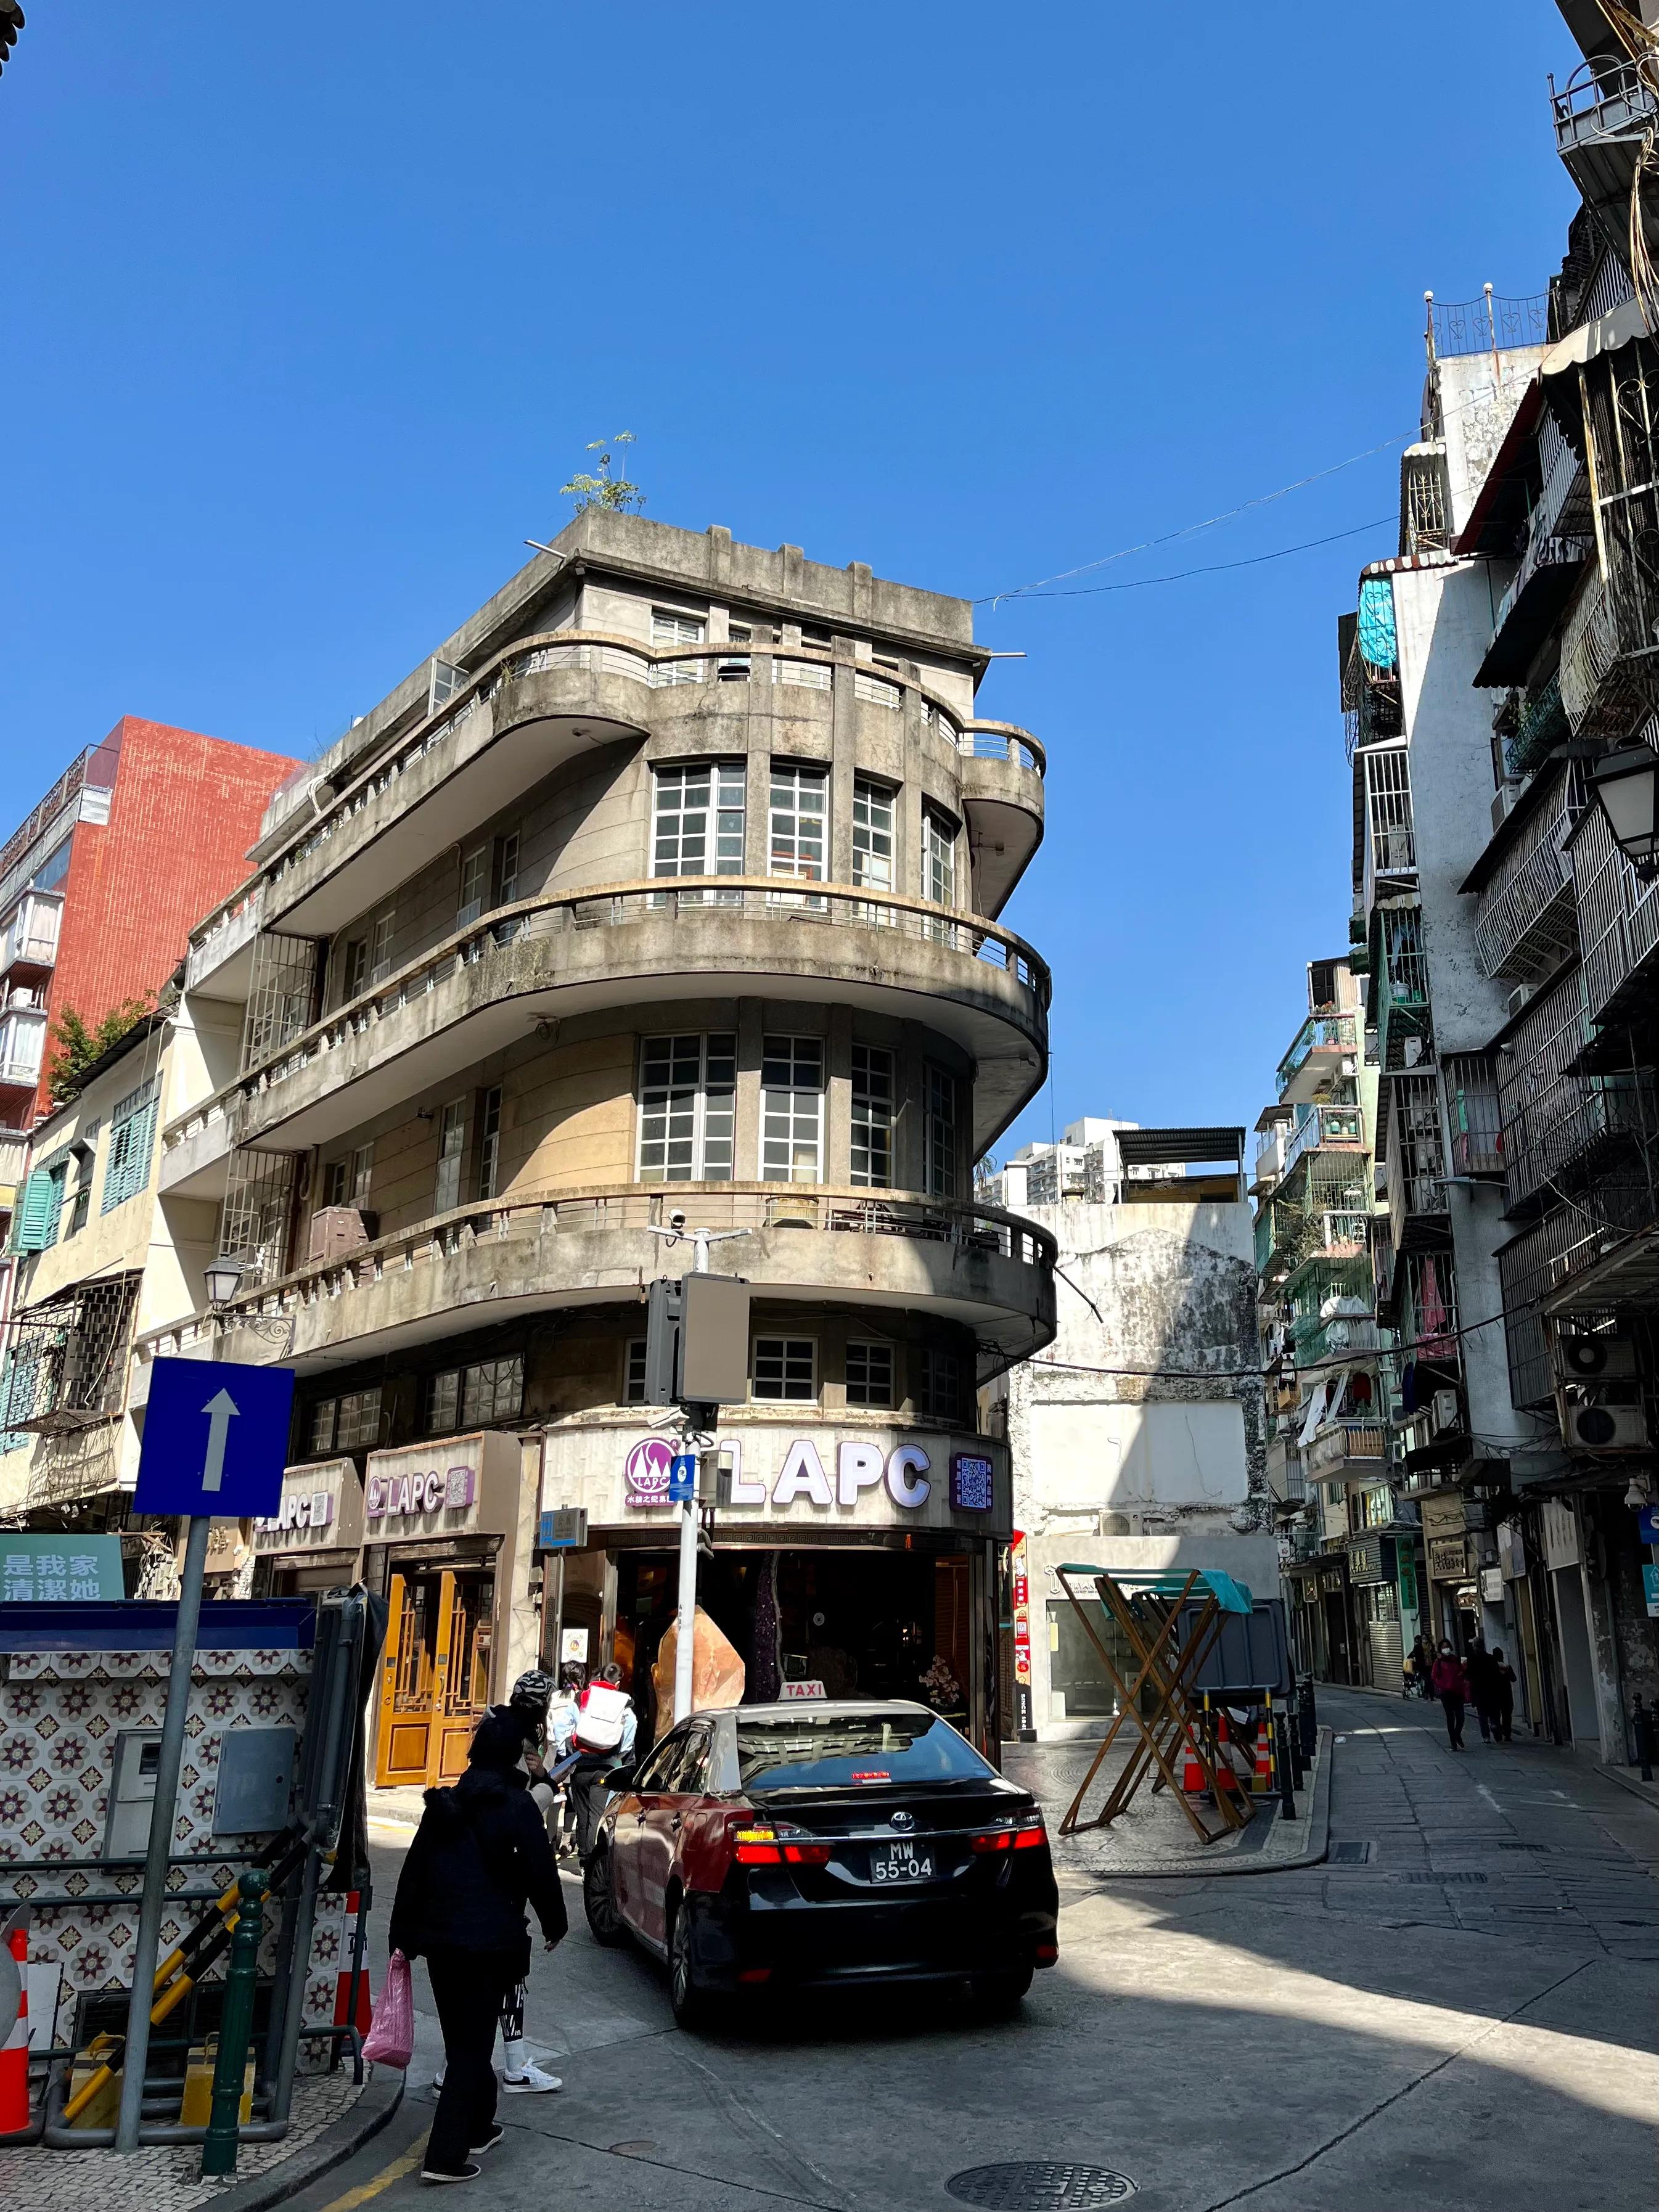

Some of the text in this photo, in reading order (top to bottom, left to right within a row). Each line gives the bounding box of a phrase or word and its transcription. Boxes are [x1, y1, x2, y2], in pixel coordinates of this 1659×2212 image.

[637, 1477, 667, 1487] LAPC
[720, 1439, 932, 1509] LAPC
[387, 1472, 440, 1514] LAPC
[3, 1554, 99, 1576] 是我家
[4, 1578, 100, 1600] 清潔她
[786, 1684, 822, 1697] TAXI
[890, 1841, 914, 1861] MW
[875, 1858, 932, 1880] 55-04
